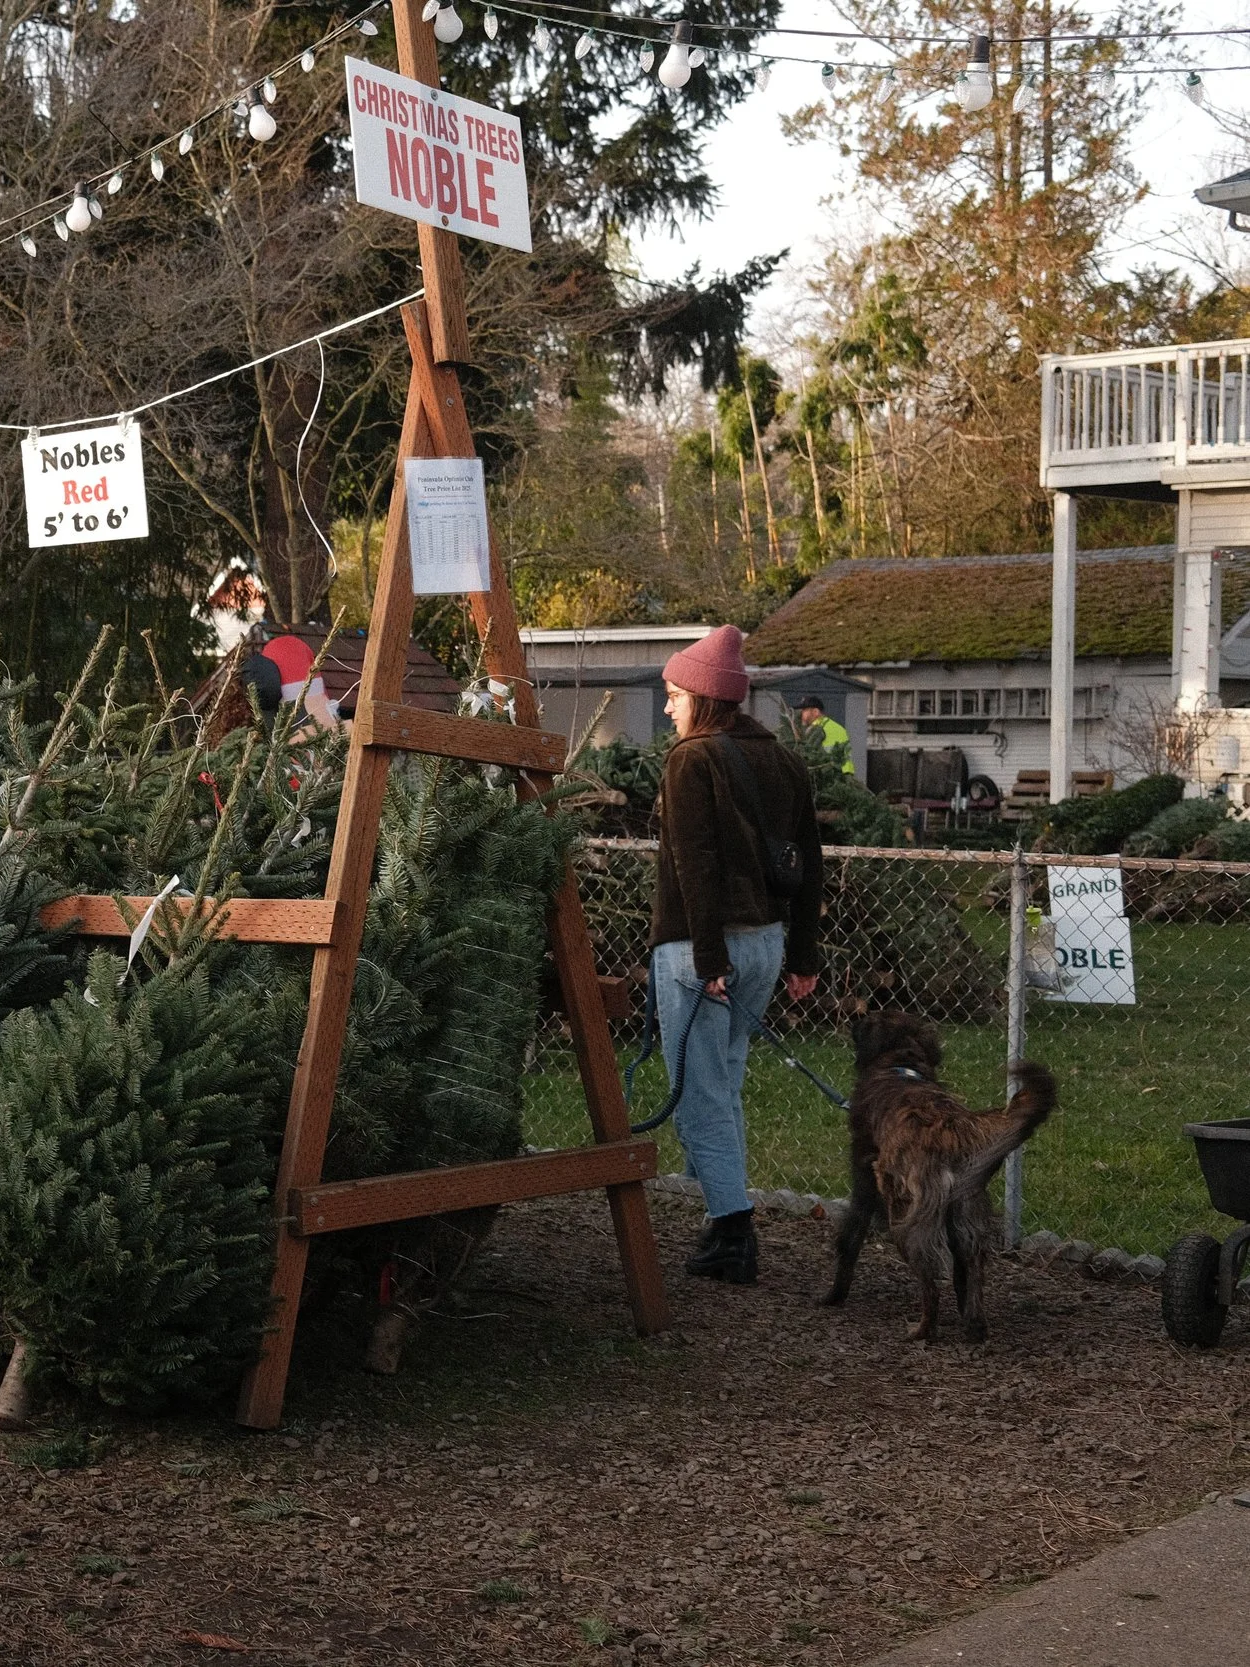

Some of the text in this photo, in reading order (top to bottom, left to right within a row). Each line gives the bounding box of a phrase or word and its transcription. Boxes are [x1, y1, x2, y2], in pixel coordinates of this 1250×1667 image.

[353, 75, 520, 165] CHRISTMAS TREES
[385, 127, 500, 229] NOBLE
[40, 440, 126, 473] Nobles
[62, 476, 109, 505] Red
[43, 505, 129, 538] 5' to 6'
[1053, 878, 1117, 898] GRAND
[1055, 947, 1126, 969] OBLE
